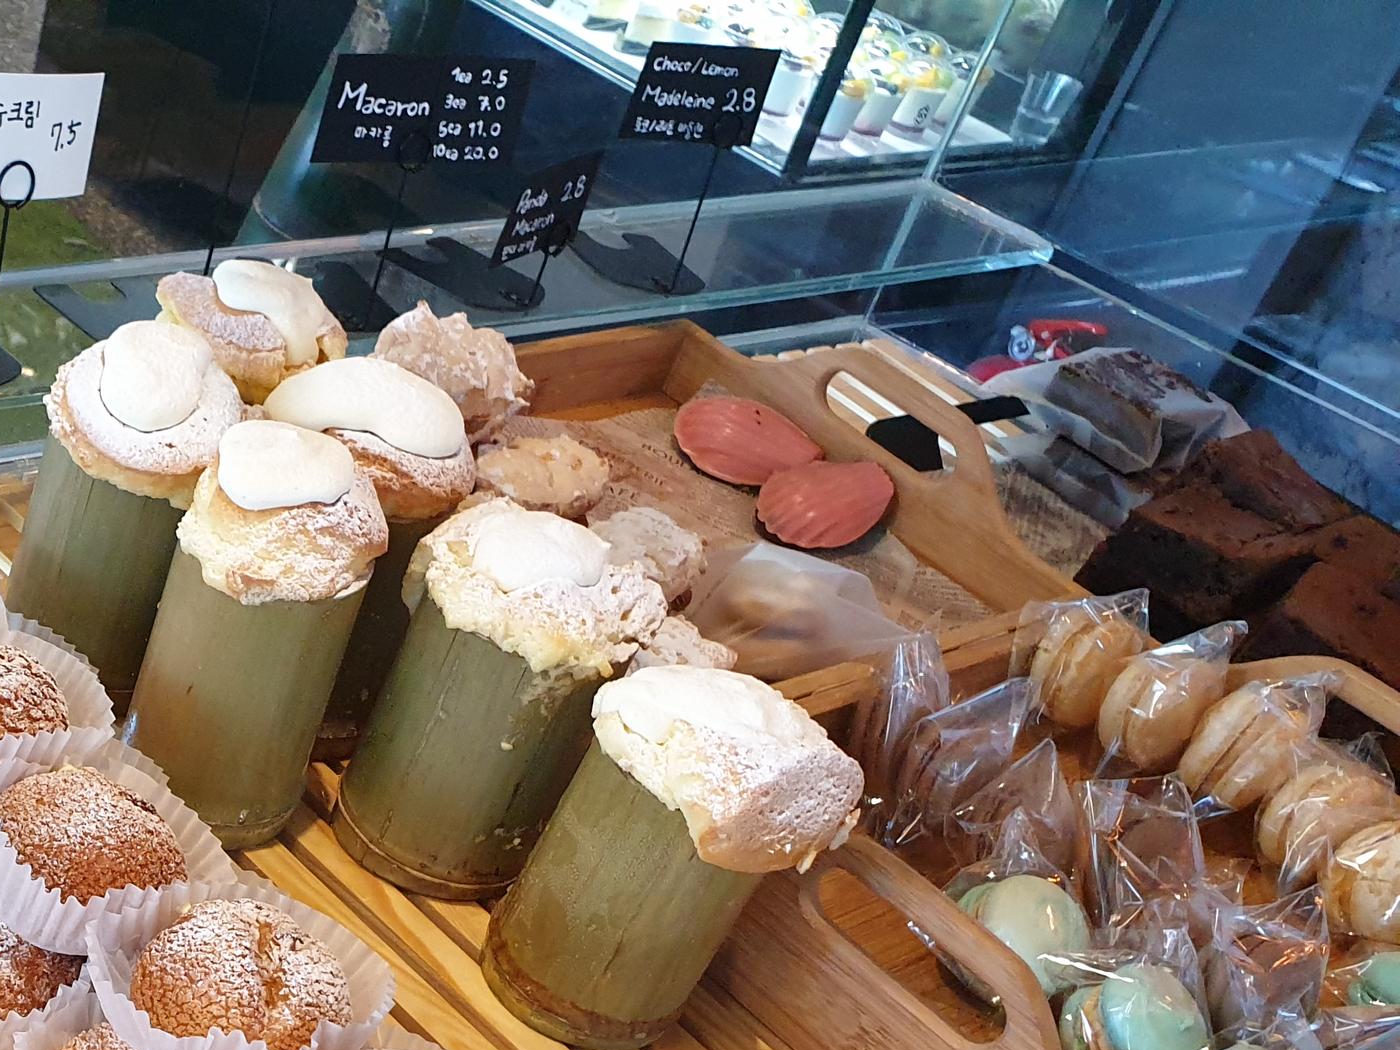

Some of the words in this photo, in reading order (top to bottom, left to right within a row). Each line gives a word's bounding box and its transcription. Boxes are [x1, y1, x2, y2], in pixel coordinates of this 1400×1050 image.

[451, 66, 473, 84] 1ea
[481, 68, 509, 89] 2.5
[337, 80, 430, 117] Macaron
[444, 93, 467, 110] 3ea
[478, 95, 506, 112] 7.0
[641, 84, 715, 110] Madeleine
[722, 87, 756, 112] 2.8
[50, 120, 82, 151] 7.5
[354, 125, 393, 148] 마카롱
[438, 120, 462, 138] 5ea
[468, 119, 502, 138] 11.0
[432, 143, 459, 161] 10ea
[463, 145, 499, 161] 20.0
[560, 174, 587, 202] 2.8
